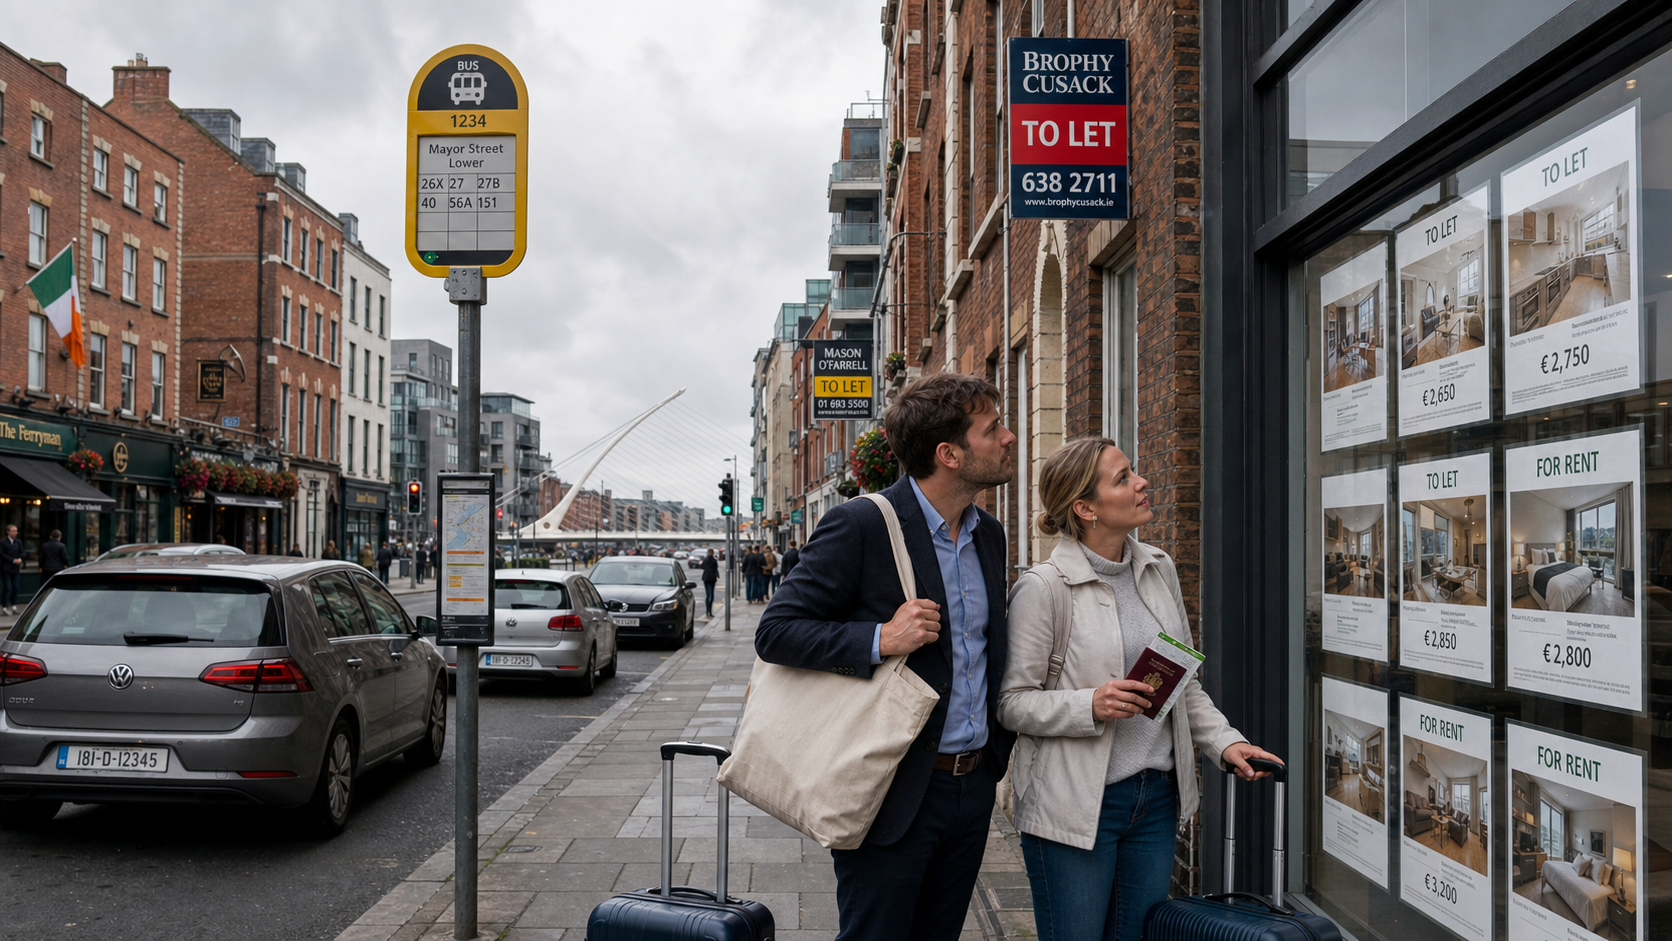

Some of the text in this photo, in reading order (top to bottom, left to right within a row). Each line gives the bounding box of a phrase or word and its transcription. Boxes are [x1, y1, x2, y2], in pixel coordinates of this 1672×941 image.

[457, 60, 479, 71] BUS
[1022, 51, 1114, 72] BROPHY
[1022, 73, 1114, 94] CUSACK
[450, 113, 487, 128] 1234
[1021, 120, 1116, 147] TO LET
[428, 143, 504, 156] Mayor Street
[449, 157, 484, 168] Lower
[1541, 146, 1588, 188] TO LET
[421, 178, 500, 190] 26X 27 27B
[1022, 171, 1117, 193] 638 2711
[421, 197, 497, 209] 40 56A 151
[1024, 197, 1114, 208] www.brophycusack.ie
[1425, 215, 1458, 247] TO LET
[824, 347, 861, 358] MASON
[818, 360, 868, 370] O'FARRELL
[821, 380, 865, 393] TO LET
[0, 421, 62, 448] The Ferryman
[1536, 450, 1599, 478] FOR RENT
[1427, 470, 1458, 490] TO LET
[1420, 714, 1465, 743] FOR RENT
[77, 750, 158, 768] 181-D-12345
[1537, 746, 1602, 783] FOR RENT
